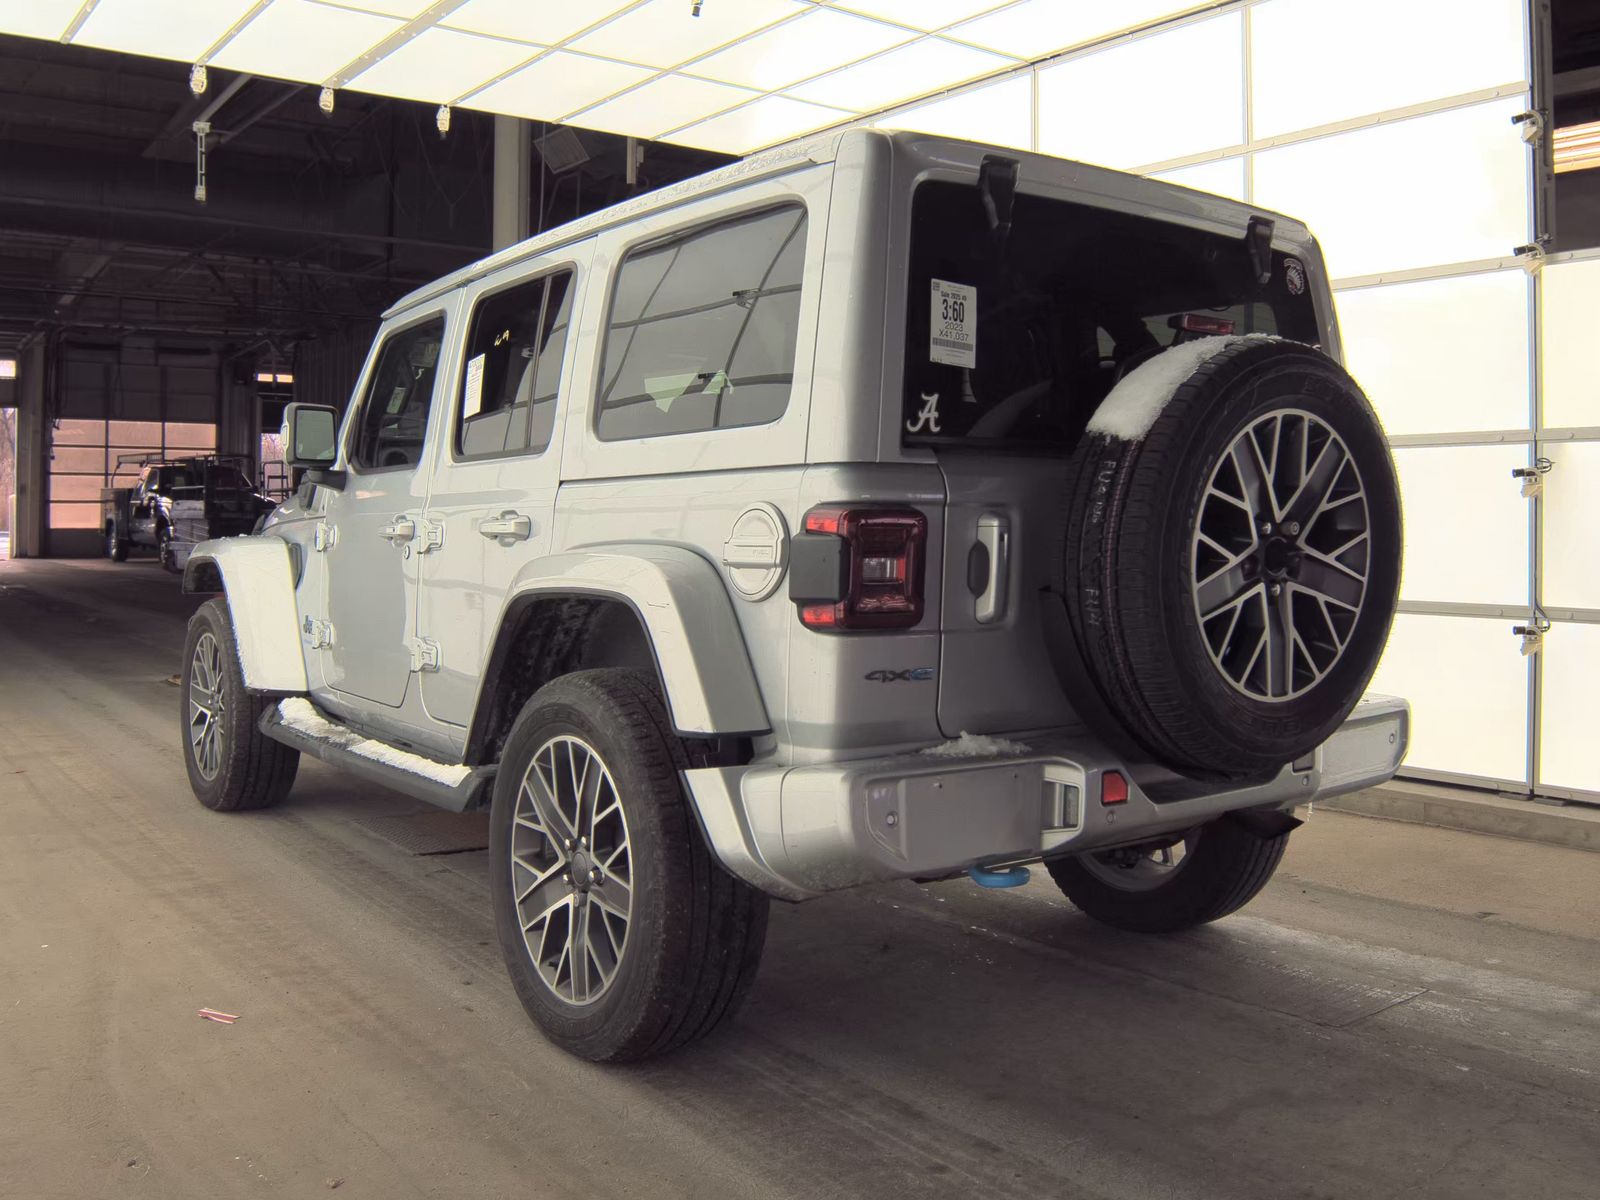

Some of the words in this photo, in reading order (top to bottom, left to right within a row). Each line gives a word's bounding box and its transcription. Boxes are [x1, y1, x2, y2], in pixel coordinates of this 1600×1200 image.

[942, 298, 965, 323] 3:60
[945, 321, 964, 332] 2023
[906, 393, 941, 432] A
